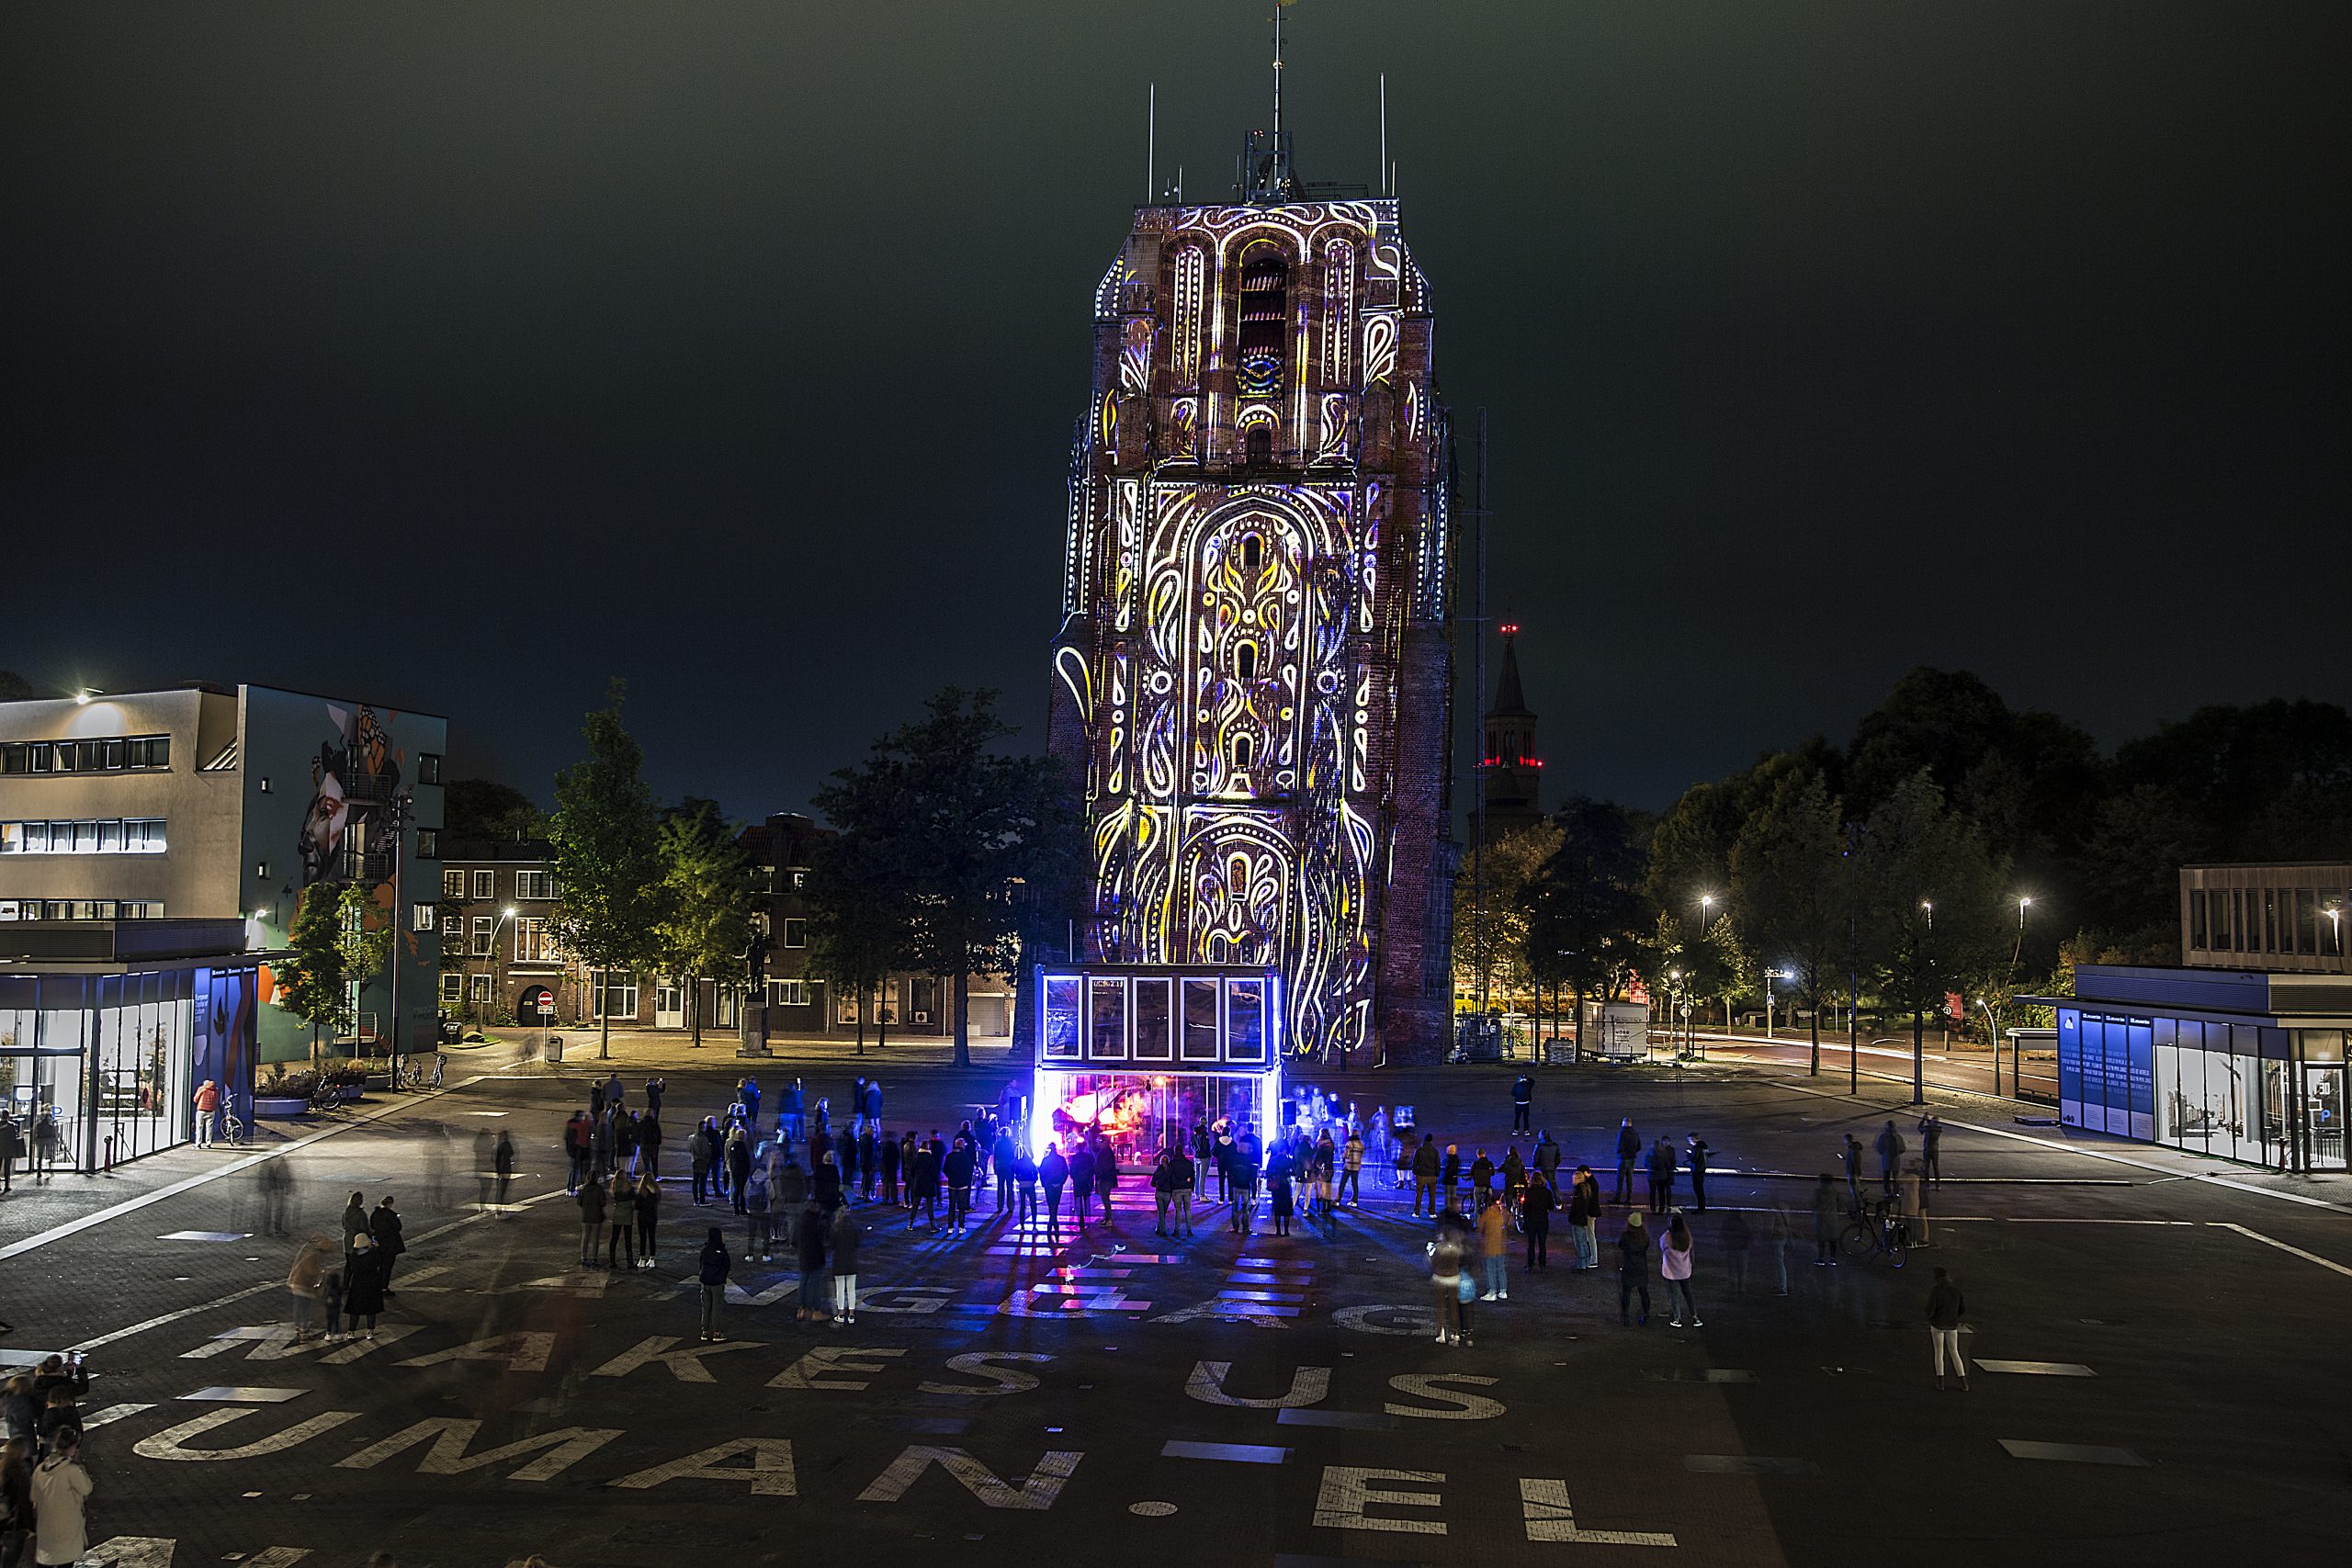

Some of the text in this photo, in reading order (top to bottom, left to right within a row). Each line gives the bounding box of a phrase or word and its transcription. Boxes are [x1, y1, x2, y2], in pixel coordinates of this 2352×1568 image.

[178, 1322, 1508, 1420] MAKES US
[1311, 1465, 1678, 1548] EL
